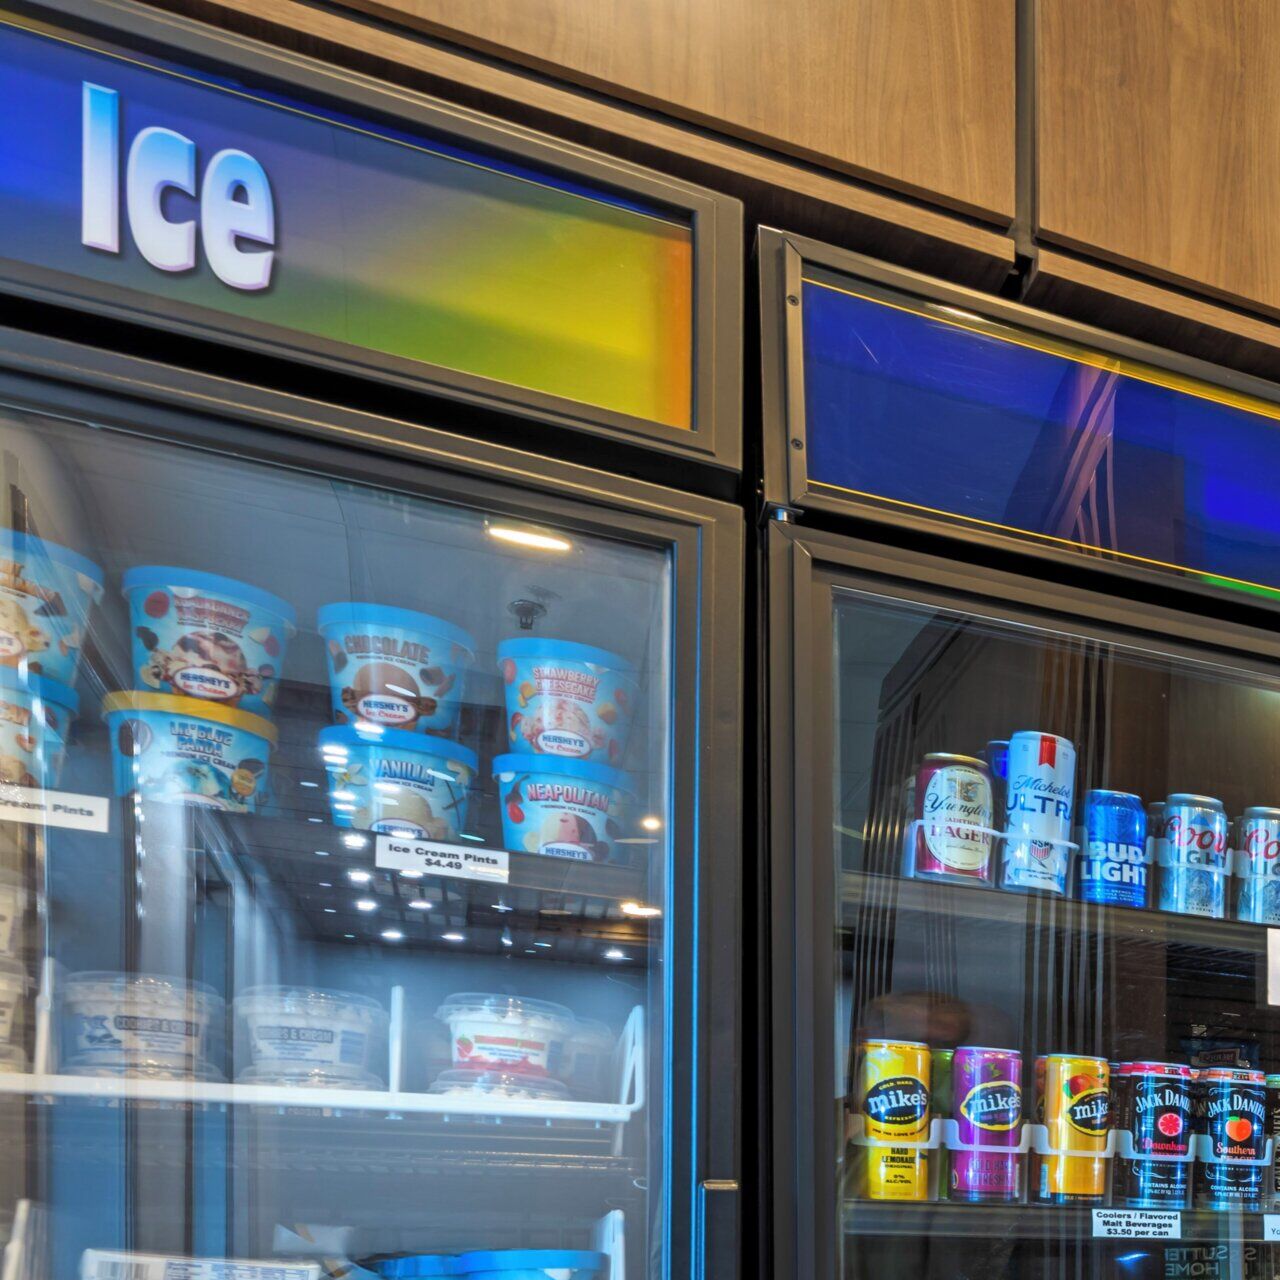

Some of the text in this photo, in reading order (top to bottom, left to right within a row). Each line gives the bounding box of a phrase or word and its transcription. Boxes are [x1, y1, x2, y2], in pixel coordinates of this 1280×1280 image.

[82, 81, 275, 290] Ice
[344, 634, 431, 664] CHOCOLATE
[180, 672, 231, 689] HERSHEY'S
[532, 666, 600, 685] STRAWBERRY
[363, 700, 409, 713] HERSHEY'S
[542, 734, 585, 748] HERSHEY'S
[370, 758, 435, 787] VANILLA
[527, 783, 610, 812] NEAPOLITAN
[52, 803, 95, 817] Pints
[388, 843, 498, 865] Ice Cream Pints
[545, 847, 588, 861] HERSHEY'S
[1089, 841, 1145, 865] BUD
[425, 858, 462, 870] $4.49
[1080, 861, 1147, 886] LIGHT
[868, 1089, 927, 1114] mike's
[970, 1094, 1021, 1114] mike's
[1136, 1093, 1164, 1113] JACK
[1208, 1098, 1232, 1118] JACK
[1217, 1141, 1256, 1155] Southern
[1096, 1211, 1178, 1221] Coolers Flavored
[1102, 1220, 1173, 1230] Malt Beverages
[1106, 1228, 1132, 1236] $3.50
[1134, 1229, 1150, 1238] per
